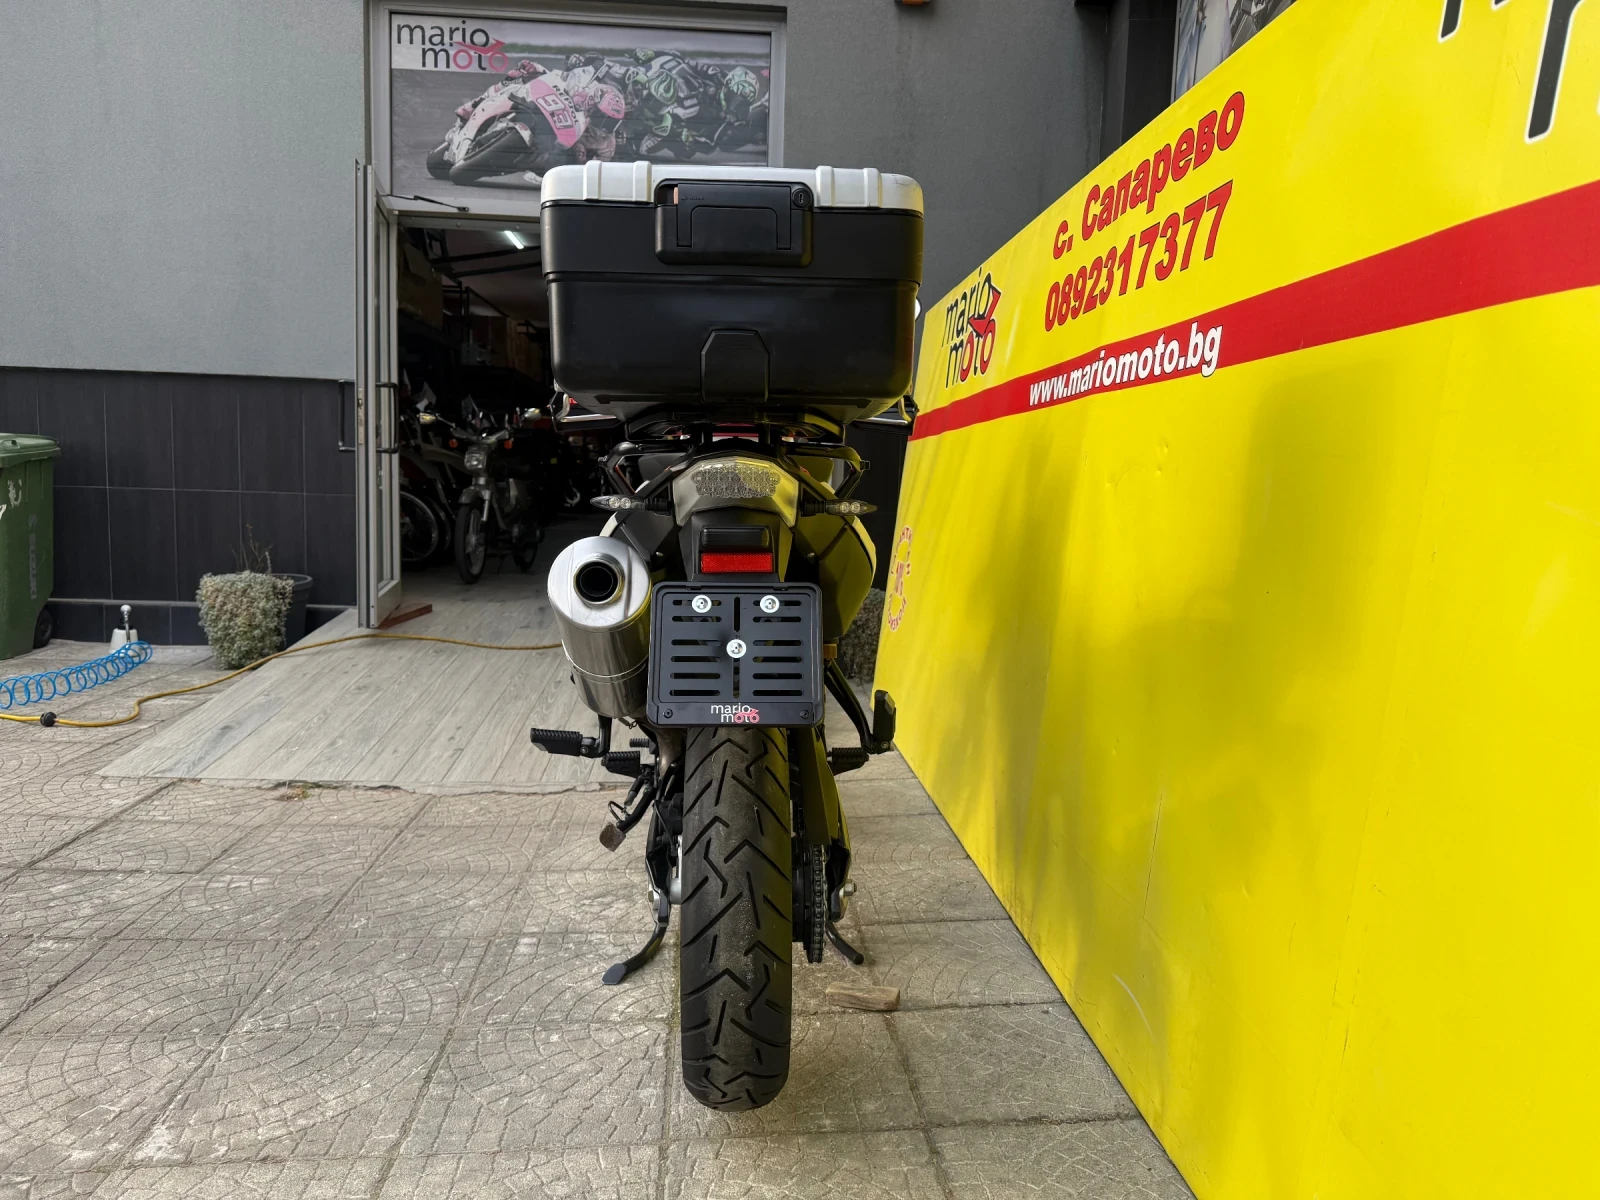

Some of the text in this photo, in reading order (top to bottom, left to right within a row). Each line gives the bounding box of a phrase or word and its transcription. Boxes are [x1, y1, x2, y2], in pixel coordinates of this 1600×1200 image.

[397, 20, 490, 47] mario
[422, 48, 509, 72] moto
[536, 93, 573, 129] 93
[1053, 91, 1245, 260] с. Сапарево
[1044, 179, 1234, 331] 0892317377
[941, 267, 992, 348] mario
[945, 319, 996, 389] moto
[1029, 321, 1223, 406] www.mariomoto.bg
[710, 702, 751, 714] mario
[720, 713, 760, 724] moto
